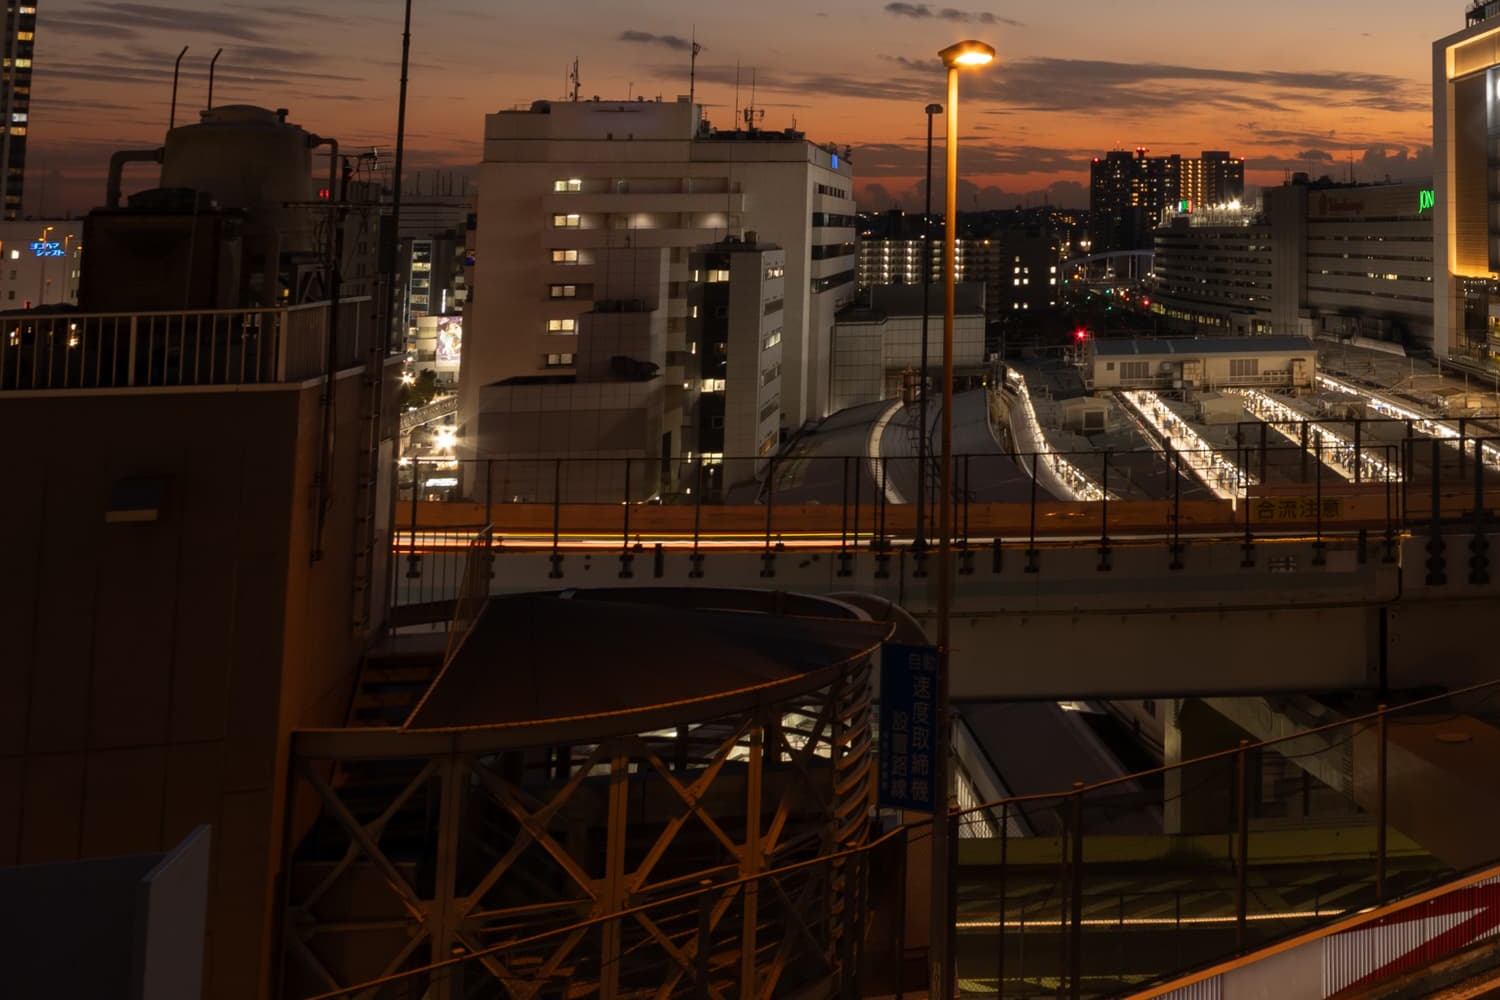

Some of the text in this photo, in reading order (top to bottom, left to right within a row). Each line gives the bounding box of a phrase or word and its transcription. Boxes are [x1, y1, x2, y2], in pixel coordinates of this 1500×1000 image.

[1257, 499, 1340, 520] 合流注意
[911, 675, 932, 801] 速度取締機
